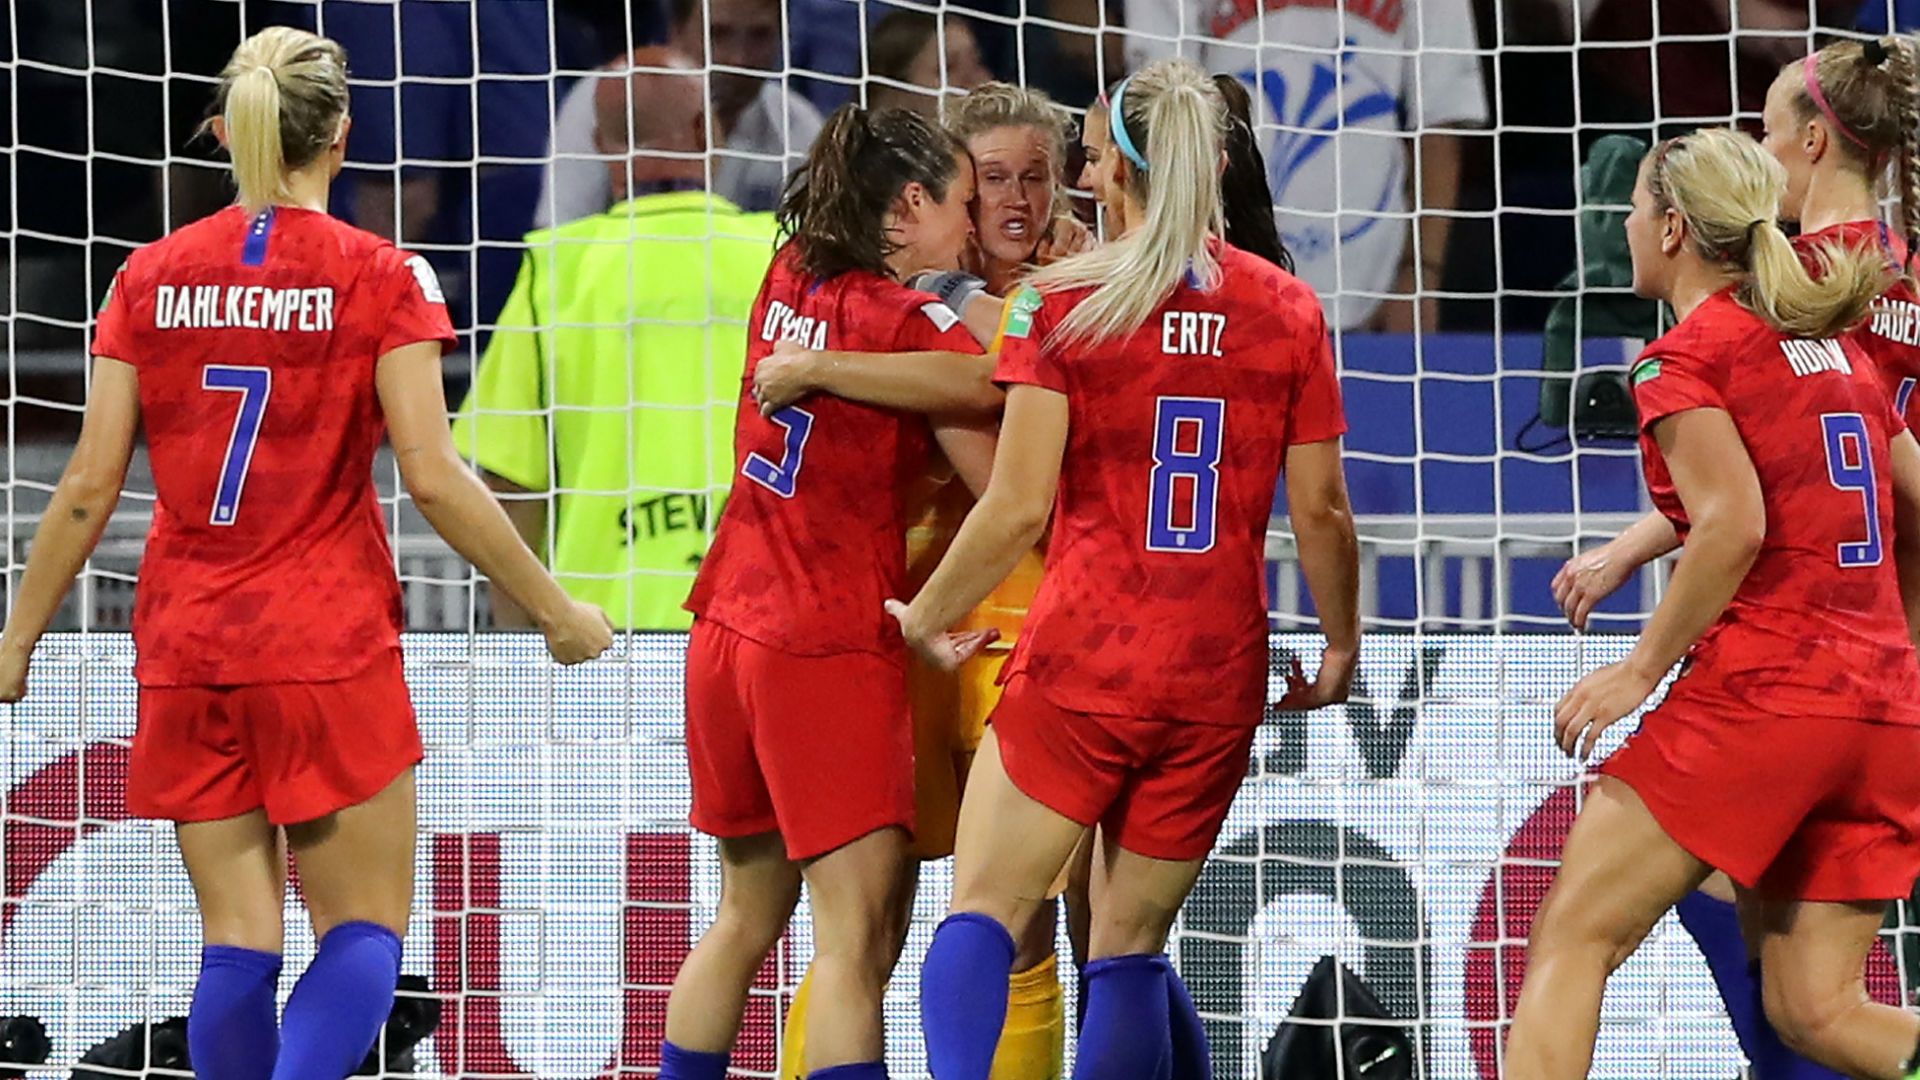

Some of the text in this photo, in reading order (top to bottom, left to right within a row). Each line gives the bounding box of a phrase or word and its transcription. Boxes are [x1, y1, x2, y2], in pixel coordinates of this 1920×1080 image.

[156, 284, 334, 332] DAHLKEMPER
[1161, 310, 1226, 357] ERTZ
[202, 364, 271, 526] 7
[1146, 396, 1225, 553] 8
[1820, 412, 1882, 567] 9
[618, 493, 728, 547] STEW
